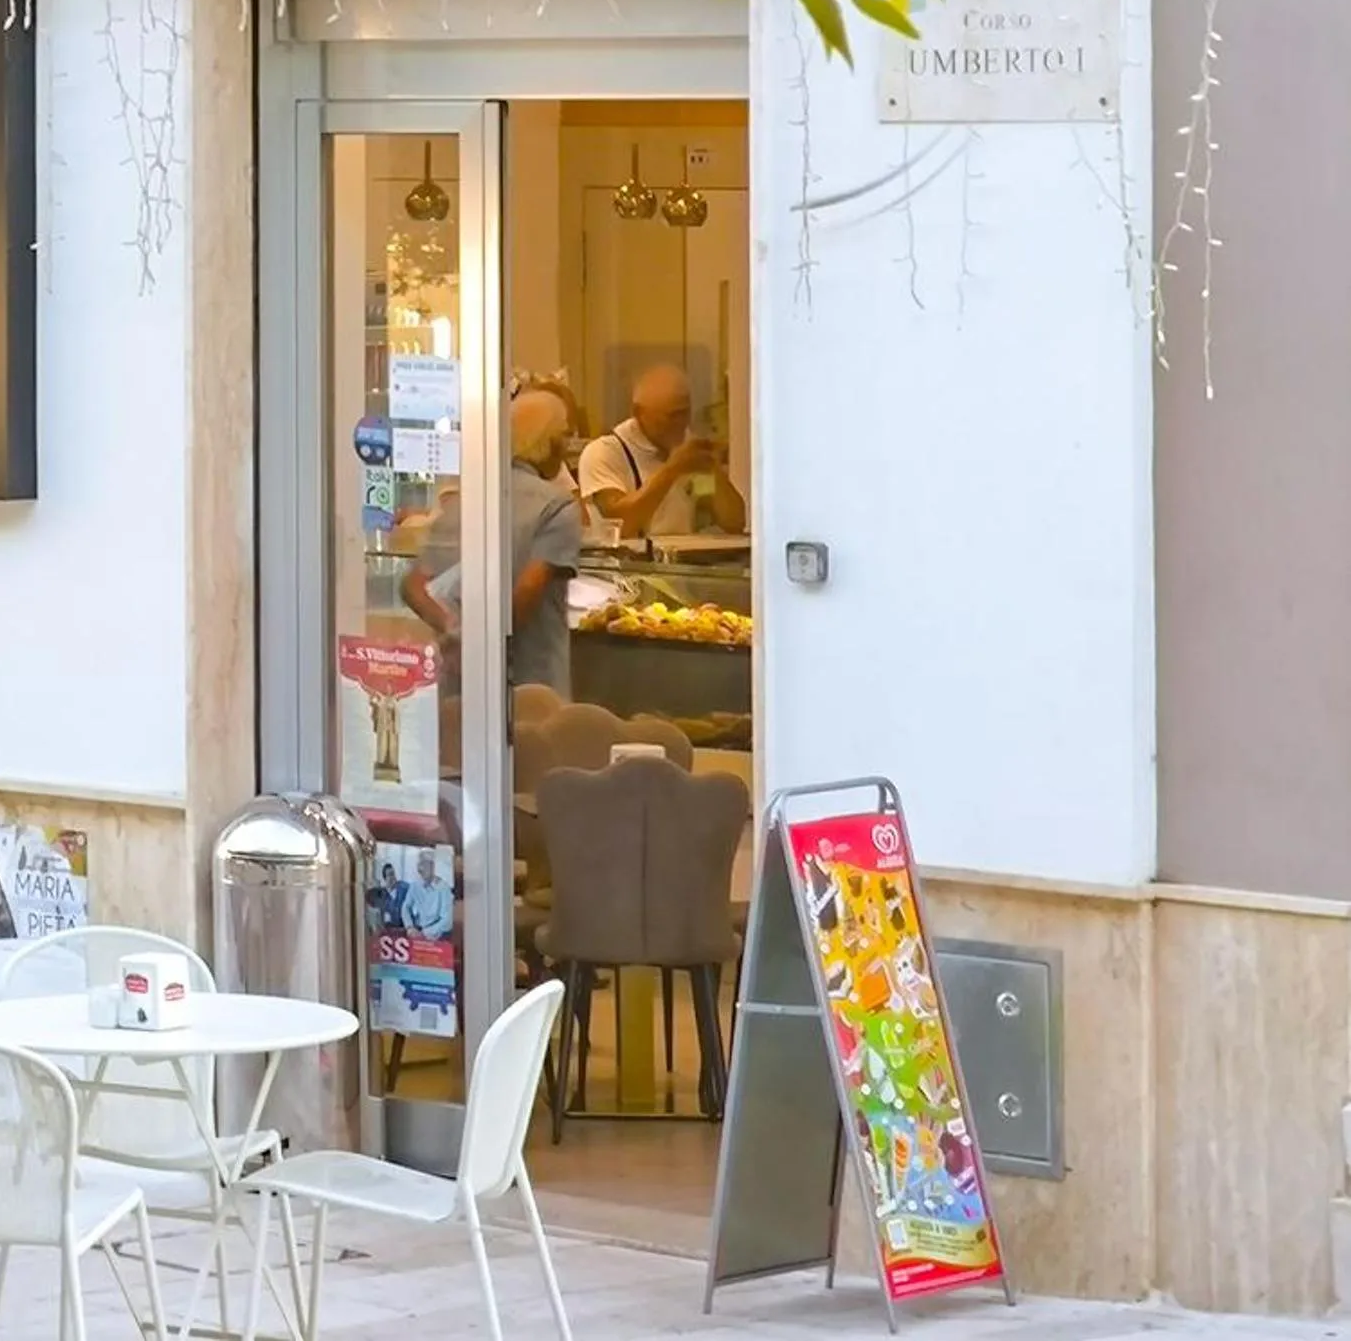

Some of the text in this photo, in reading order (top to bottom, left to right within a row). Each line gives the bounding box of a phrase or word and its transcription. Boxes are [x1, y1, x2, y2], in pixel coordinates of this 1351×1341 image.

[910, 46, 1085, 77] UMBERTO I
[15, 872, 75, 901] MARIA
